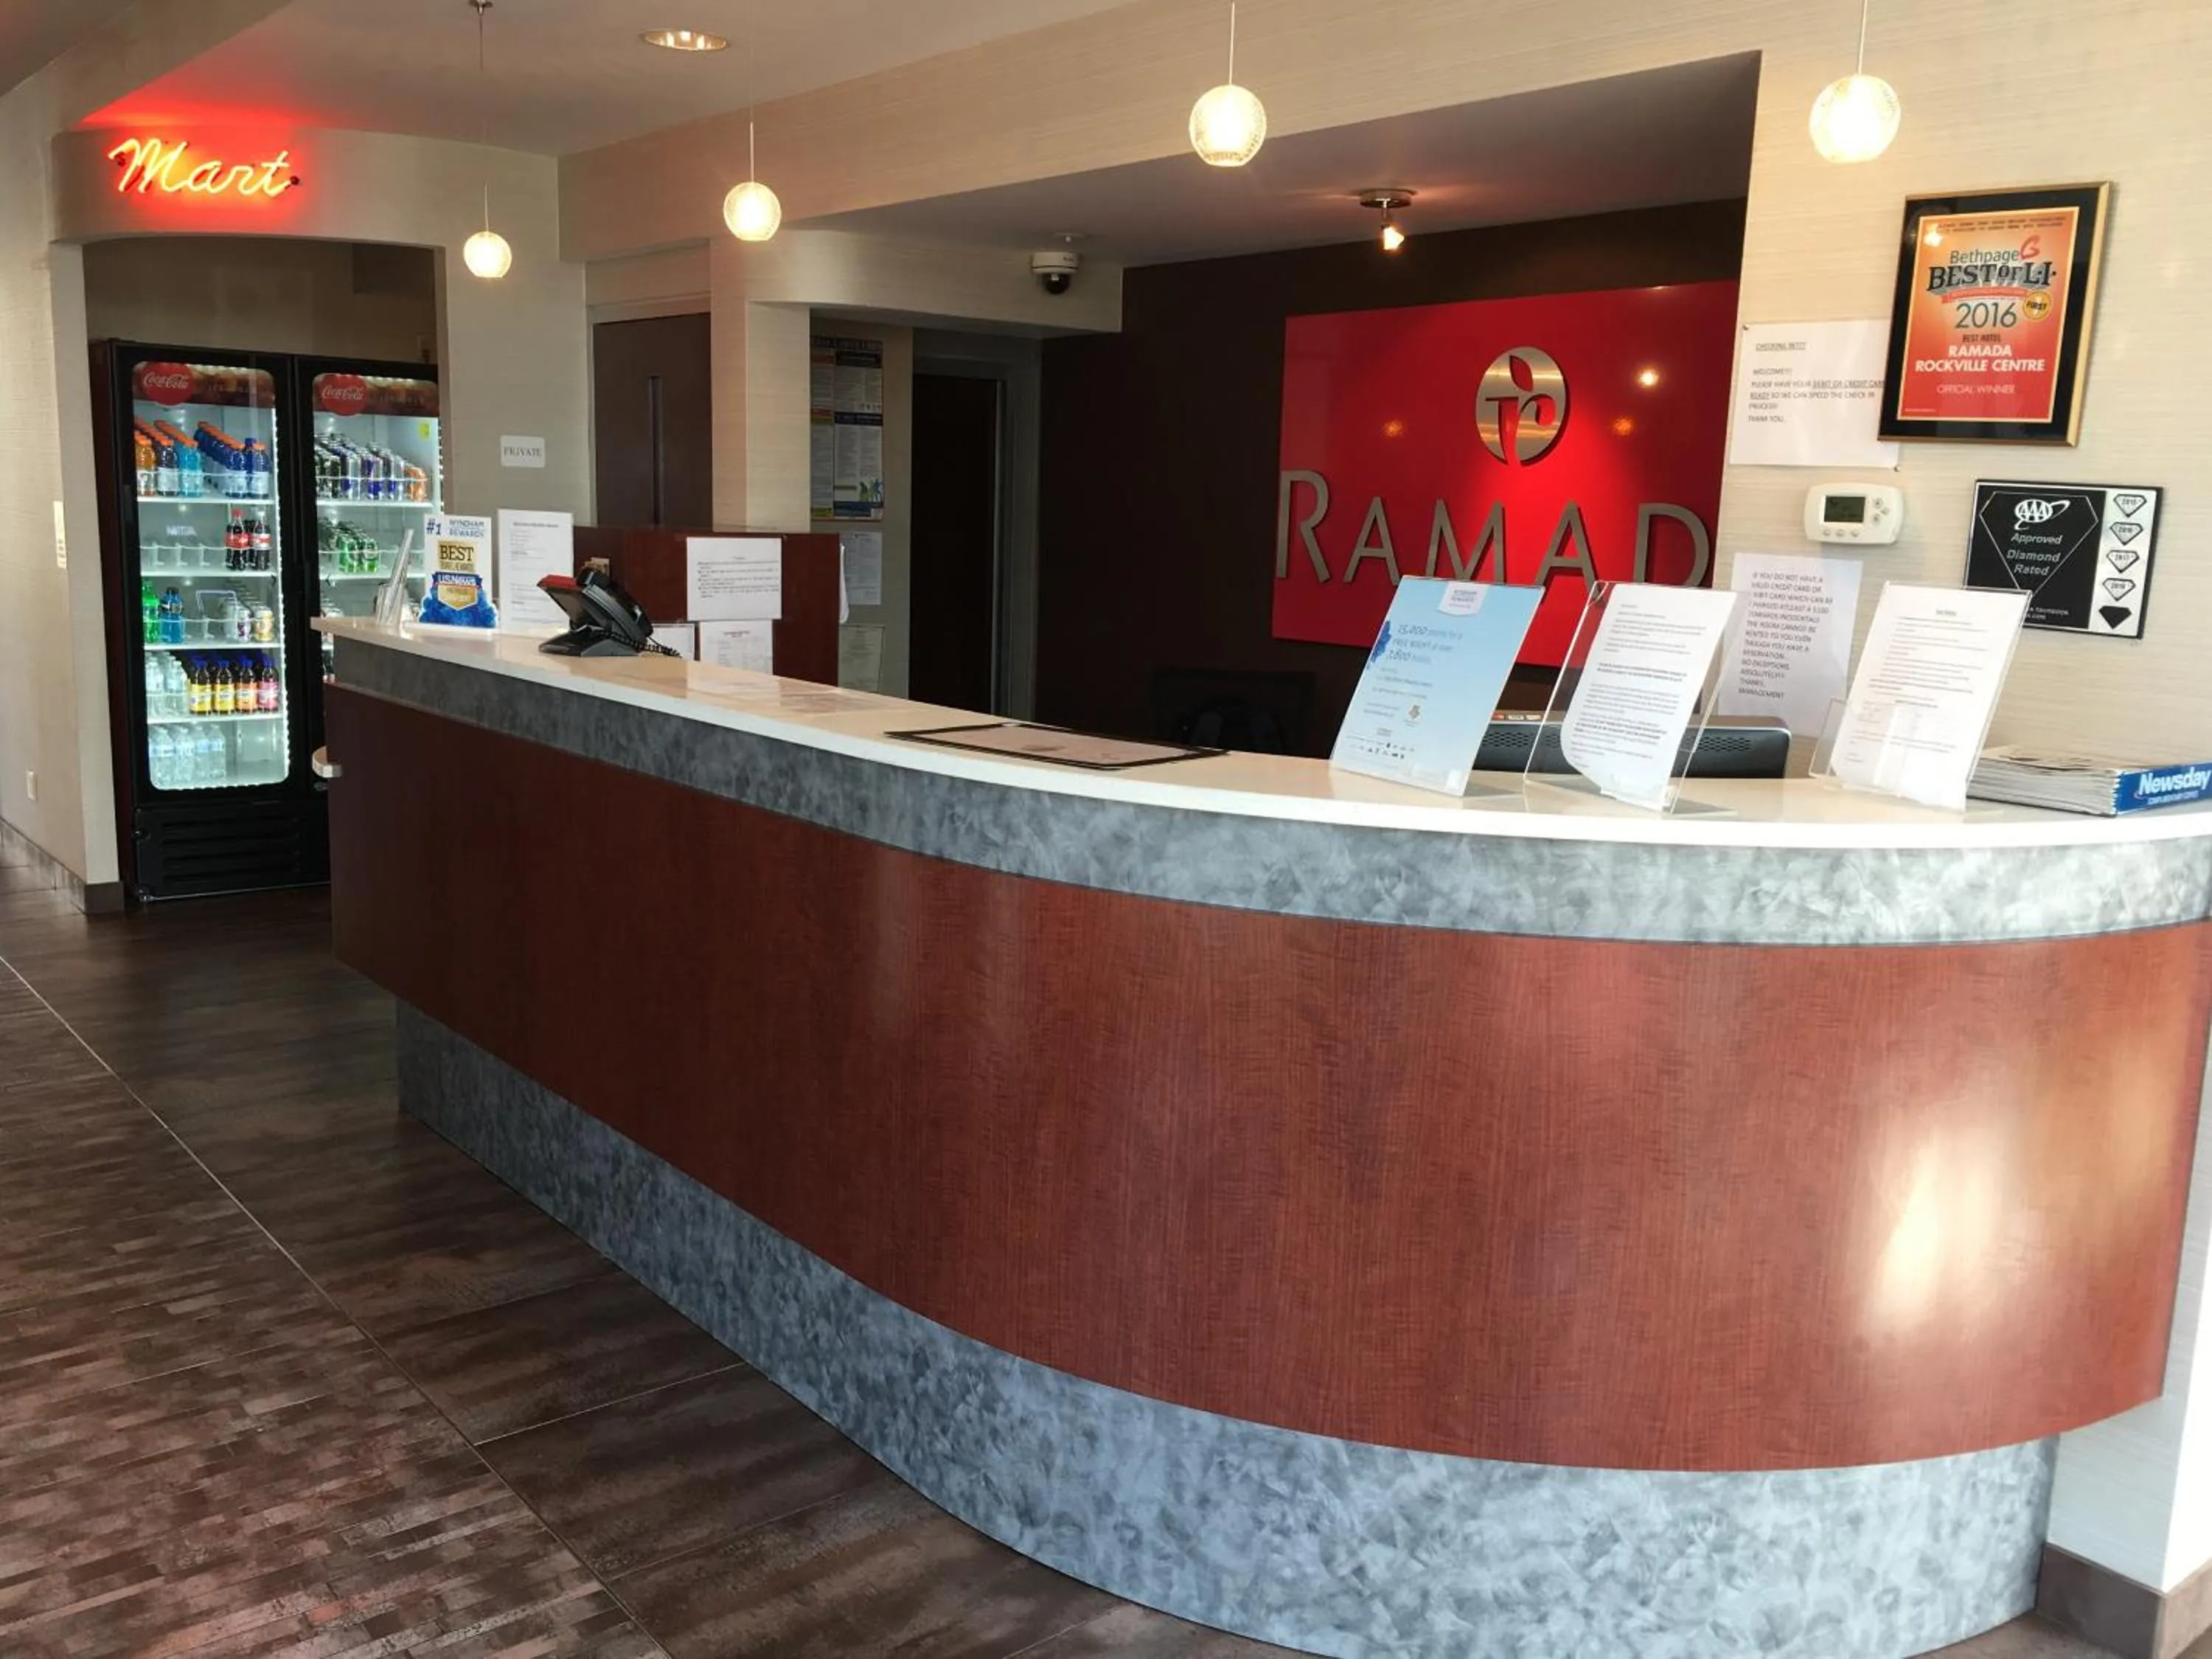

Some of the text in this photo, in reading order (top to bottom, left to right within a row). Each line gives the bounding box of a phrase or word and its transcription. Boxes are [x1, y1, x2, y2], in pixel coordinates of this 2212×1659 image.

[108, 138, 291, 198] Mart
[1950, 248, 2020, 264] Bethpage
[1927, 264, 1997, 291] BEST
[2026, 301, 2048, 311] FIRST
[1955, 302, 2017, 328] 2016
[1962, 334, 2001, 343] BEST HOTEL
[1949, 344, 2012, 357] RAMADA
[1915, 359, 2045, 372] ROCKVILLE CENTRE
[1936, 384, 2016, 394] OFFICIAL WINNER
[504, 446, 541, 456] PRIVATE
[2018, 501, 2050, 519] AAA
[426, 518, 442, 535] #1
[2011, 533, 2063, 546] Approved
[439, 545, 474, 562] BEST
[2007, 549, 2061, 562] Diamond
[2014, 564, 2051, 577] Rated
[2138, 767, 2212, 796] Newsday
